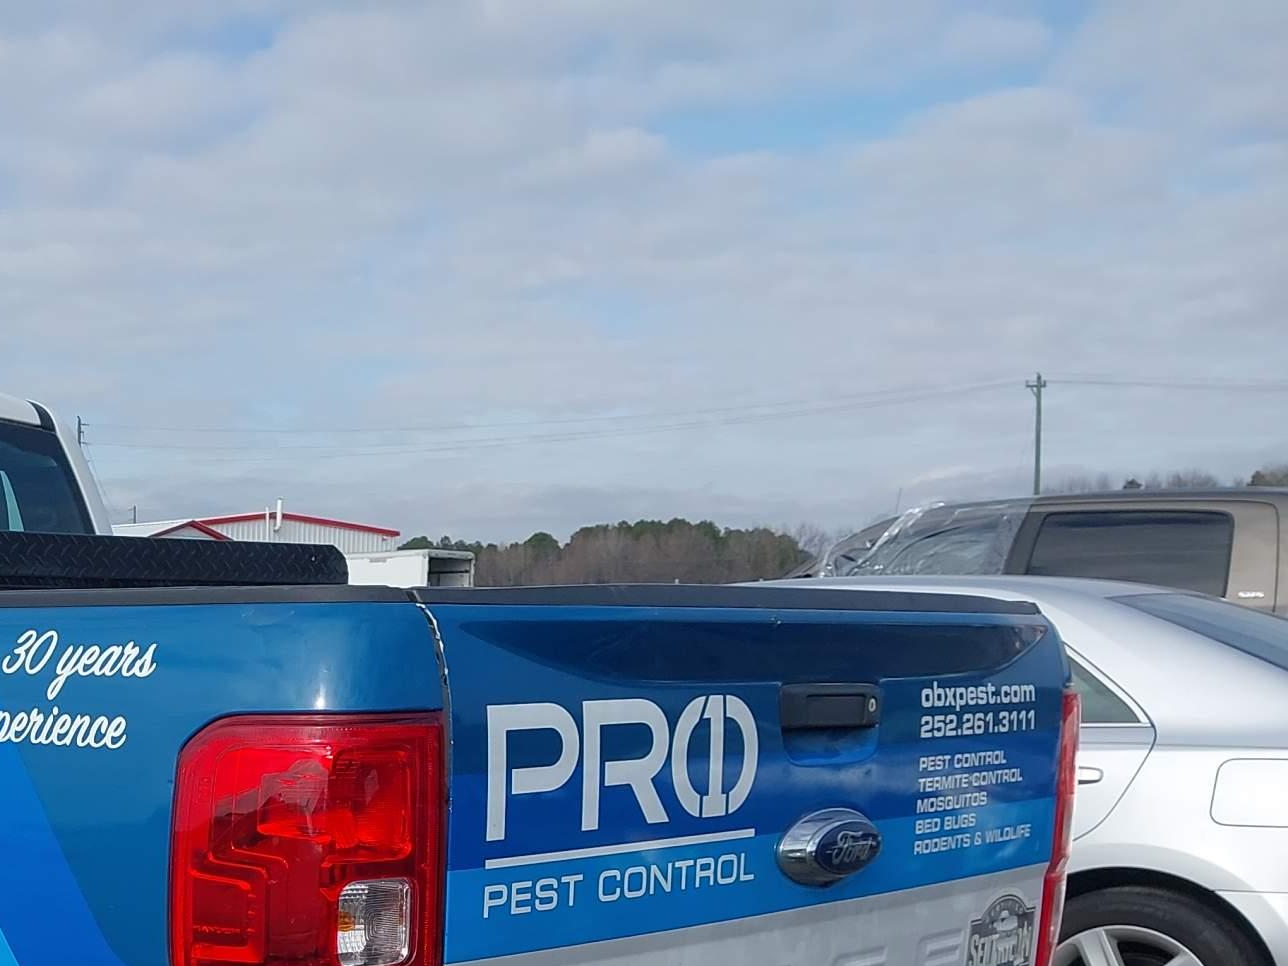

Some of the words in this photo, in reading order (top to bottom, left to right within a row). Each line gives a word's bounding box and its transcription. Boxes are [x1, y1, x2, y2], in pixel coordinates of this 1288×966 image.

[2, 629, 58, 675] 30
[46, 641, 157, 700] years
[920, 681, 1036, 711] obxpest.com
[920, 710, 1036, 739] 252.261.3111
[919, 754, 952, 772] PEST
[954, 750, 1008, 769] CONTROL
[918, 774, 970, 793] TERMITE
[970, 768, 1024, 787] CONTROL
[916, 791, 988, 814] MOSQUITOS
[915, 817, 941, 835] BED
[943, 813, 977, 831] BUGS
[826, 831, 878, 865] Ford
[913, 834, 971, 856] RODENTS
[974, 831, 982, 846] &
[985, 824, 1032, 844] WILDLIFE
[483, 874, 584, 919] PEST
[598, 853, 755, 902] CONTROL
